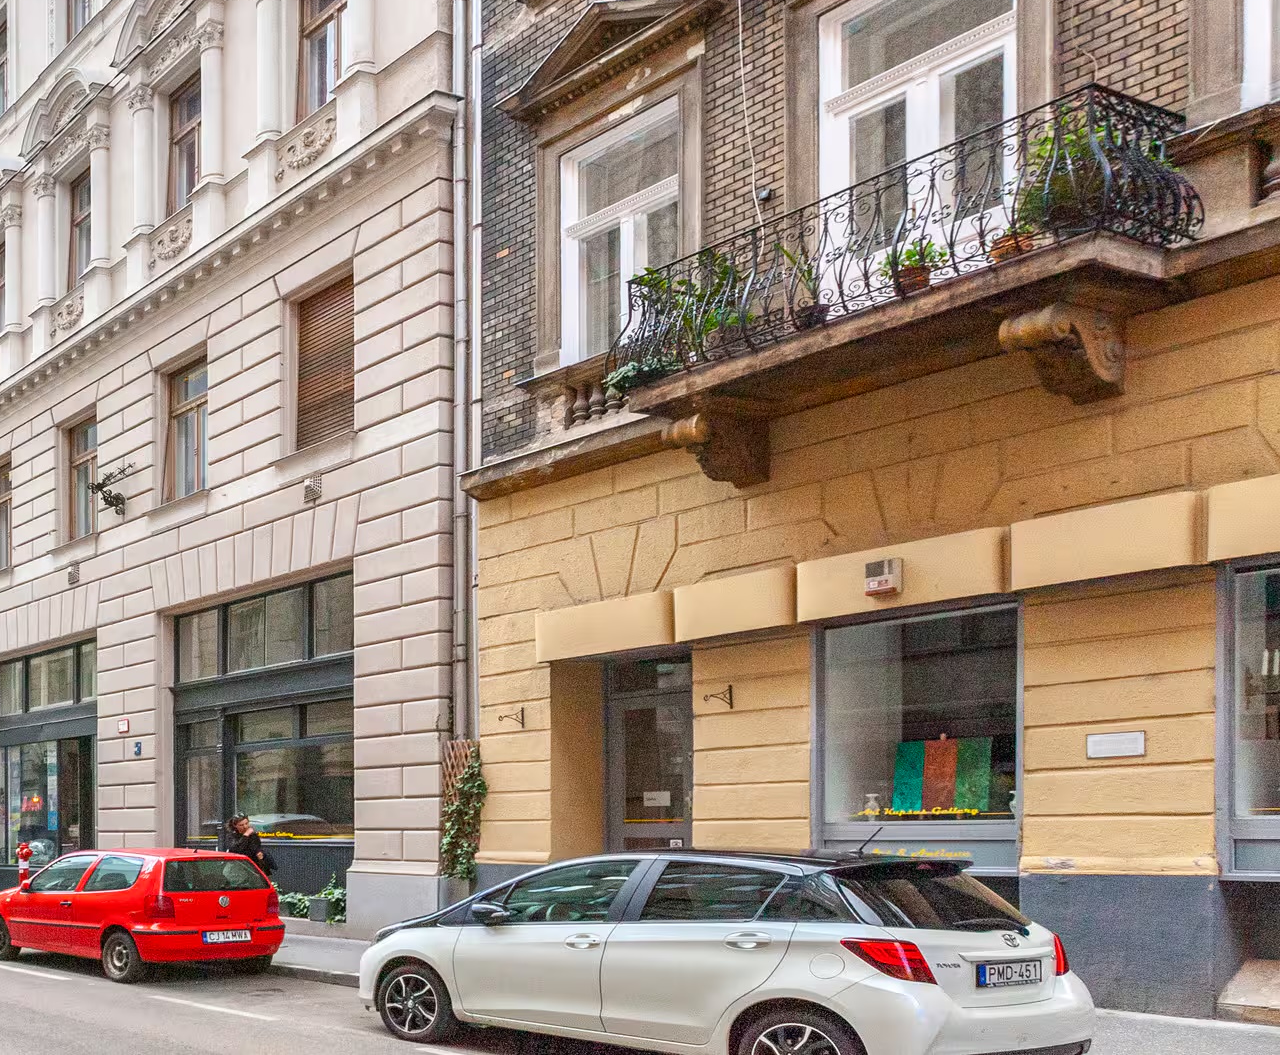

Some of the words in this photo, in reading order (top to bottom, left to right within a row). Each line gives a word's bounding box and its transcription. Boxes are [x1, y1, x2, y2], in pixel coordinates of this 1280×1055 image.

[134, 741, 142, 756] 3
[931, 806, 979, 816] Gallery
[988, 964, 1037, 982] PMD-451
